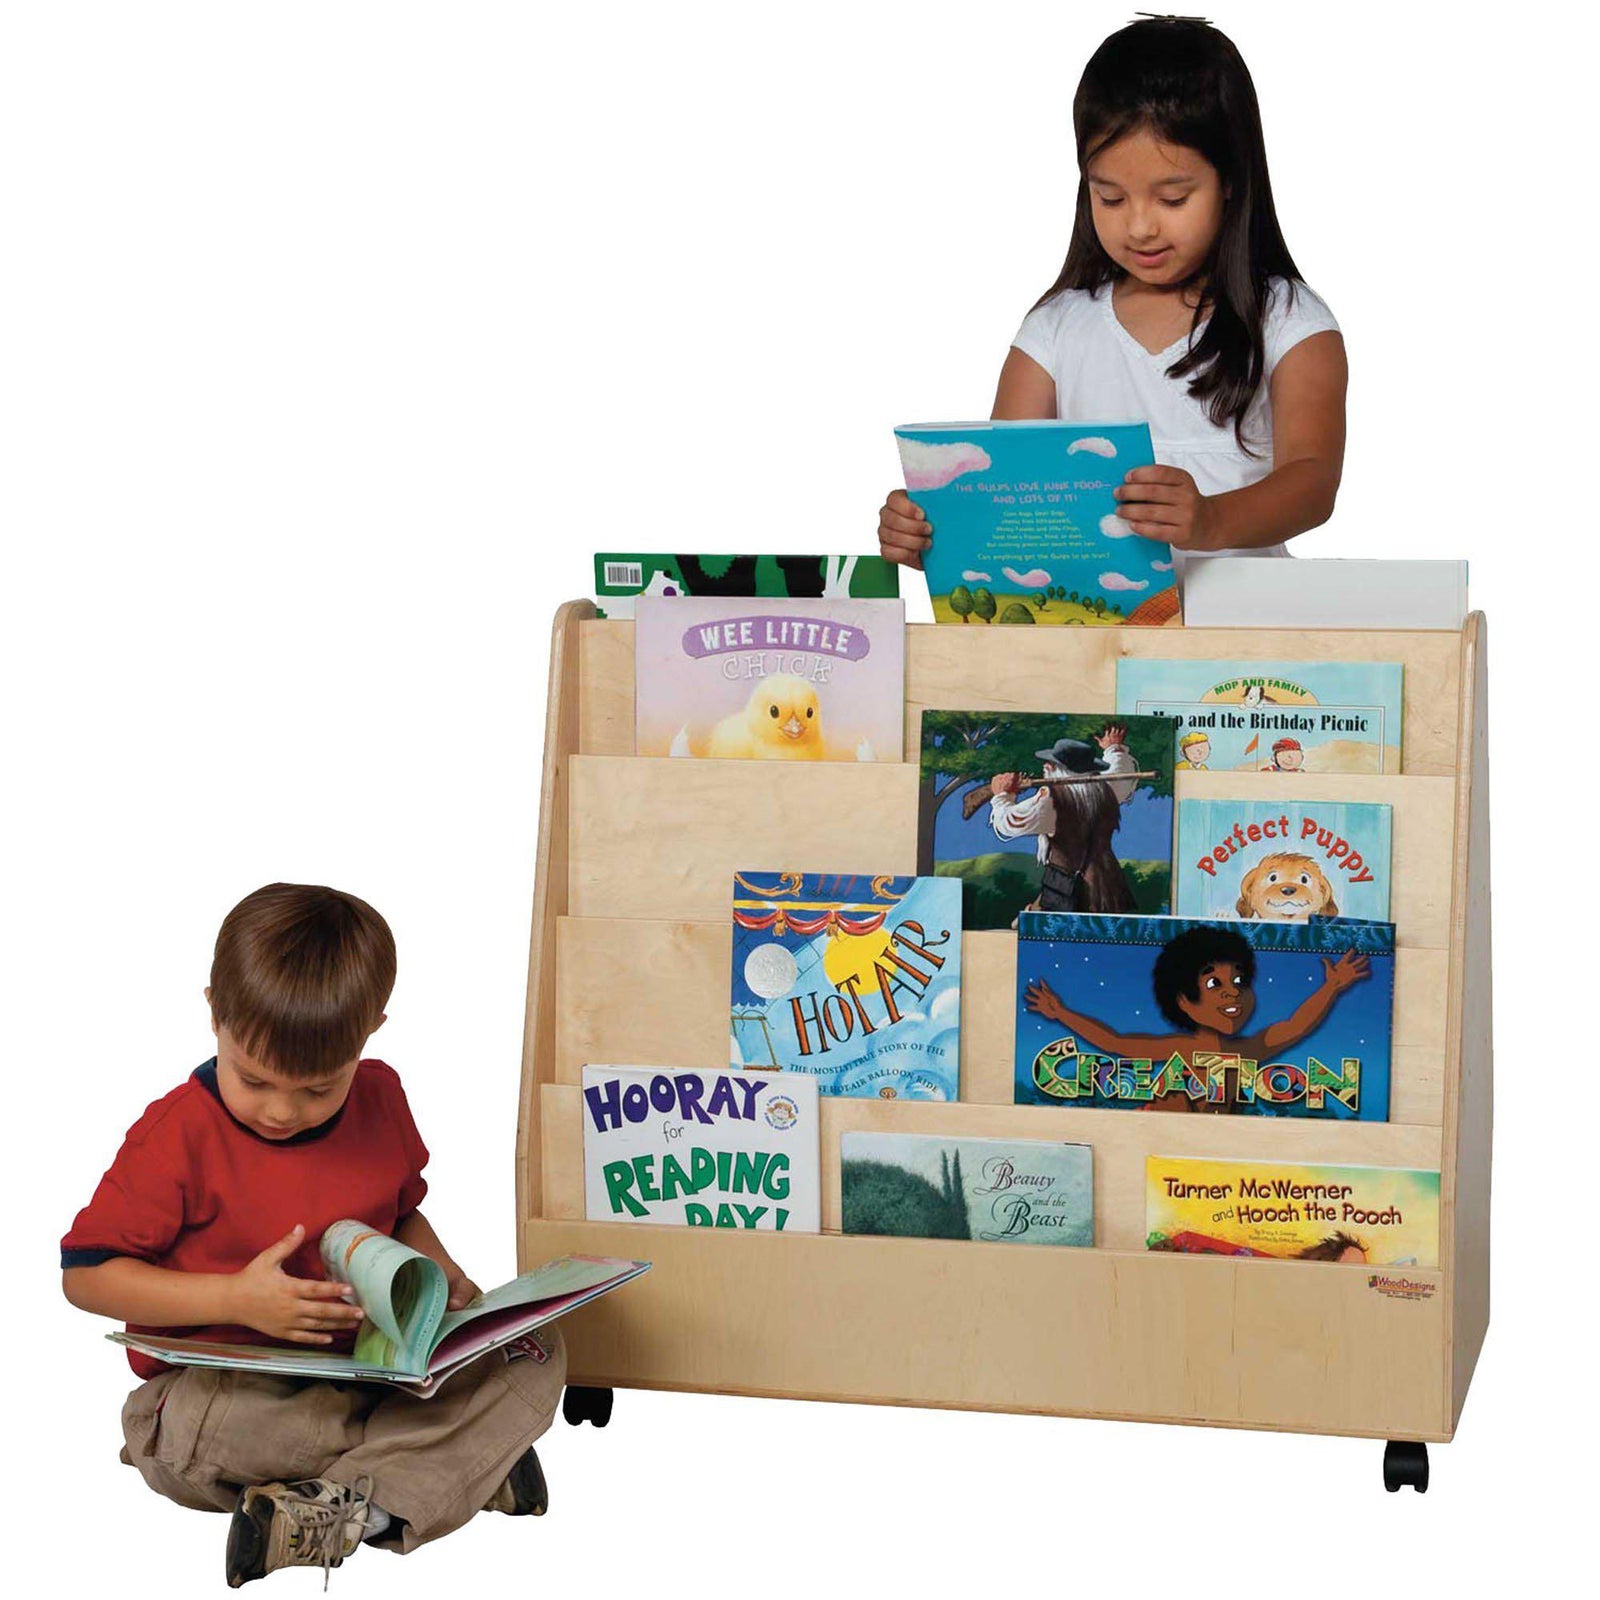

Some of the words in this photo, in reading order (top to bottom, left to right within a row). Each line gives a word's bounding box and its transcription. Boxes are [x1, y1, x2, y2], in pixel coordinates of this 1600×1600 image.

[955, 484, 973, 492] THE
[977, 482, 1010, 492] GULPS
[1014, 481, 1039, 492] LOVE
[1043, 481, 1069, 491] JUNK
[993, 494, 1015, 504] AND
[1019, 494, 1044, 504] LOTS
[1048, 494, 1061, 503] OF
[699, 621, 754, 651] WEE
[766, 621, 853, 654] LITTLE
[722, 653, 834, 683] CHICK
[1214, 680, 1239, 695] MOP
[1242, 679, 1265, 687] AND
[1267, 679, 1308, 697] FAMILY
[1188, 712, 1216, 728] and
[1220, 712, 1245, 729] the
[1250, 713, 1316, 733] Birthday
[1321, 715, 1369, 732] Picnic
[1196, 815, 1289, 877] Perfect
[1300, 817, 1375, 883] Puppy
[787, 973, 878, 1057] HOT
[873, 919, 951, 1026] AIR
[789, 1063, 808, 1074] THE
[810, 1061, 853, 1075] (MOSTLY)
[853, 1049, 877, 1067] TRUE
[878, 1042, 908, 1056] STORY
[910, 1042, 924, 1051] OF
[926, 1045, 945, 1057] THE
[868, 1068, 914, 1082] BALLOON
[916, 1075, 939, 1094] RIDE
[1032, 1036, 1360, 1112] CREATION
[584, 1073, 768, 1133] HOORAY
[663, 1120, 685, 1144] for
[602, 1147, 790, 1218] READING
[972, 1156, 1056, 1195] Beauty
[1163, 1177, 1233, 1200] Turner
[1238, 1178, 1353, 1201] McWerner
[1031, 1193, 1050, 1207] and
[1052, 1194, 1067, 1207] the
[1212, 1206, 1235, 1223] and
[1236, 1203, 1300, 1225] Hooch
[1303, 1202, 1337, 1221] the
[1342, 1202, 1402, 1226] Pooch
[980, 1193, 1068, 1241] Beast
